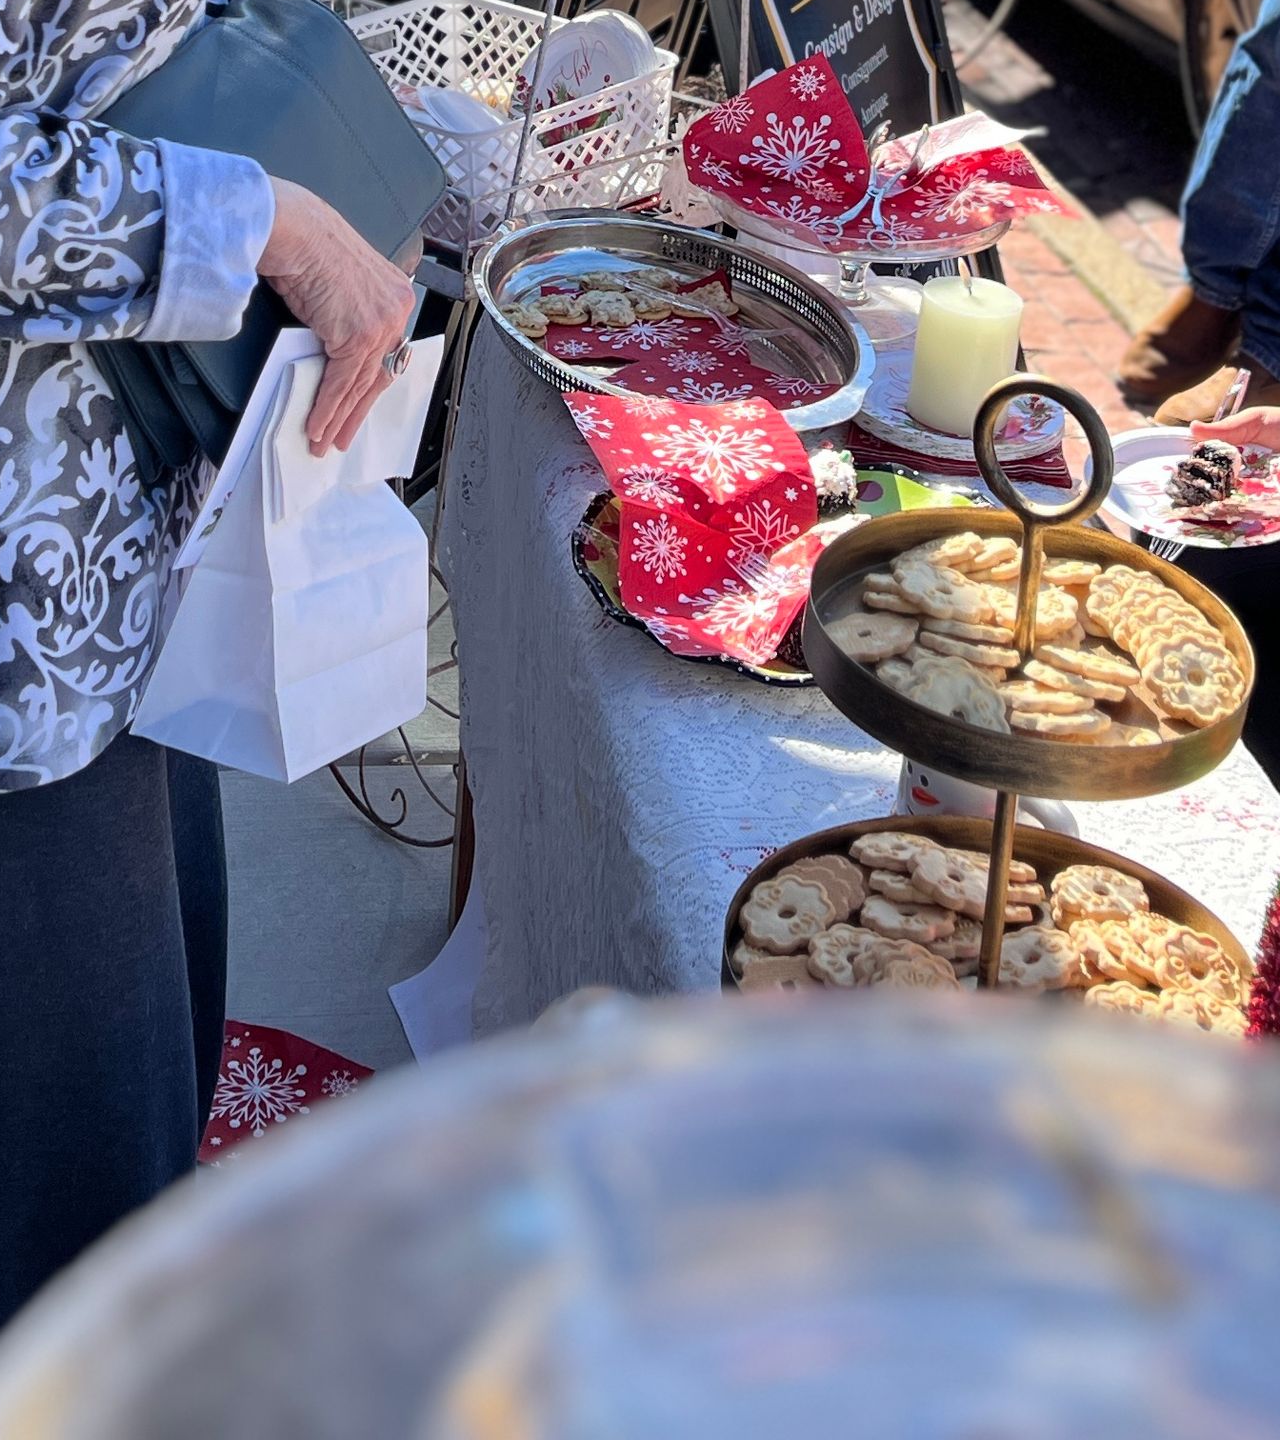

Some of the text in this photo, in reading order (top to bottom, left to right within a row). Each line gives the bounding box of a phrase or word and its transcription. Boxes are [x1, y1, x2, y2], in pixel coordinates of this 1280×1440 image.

[852, 4, 864, 33] &
[841, 43, 889, 95] Consignment
[861, 92, 889, 128] Antique
